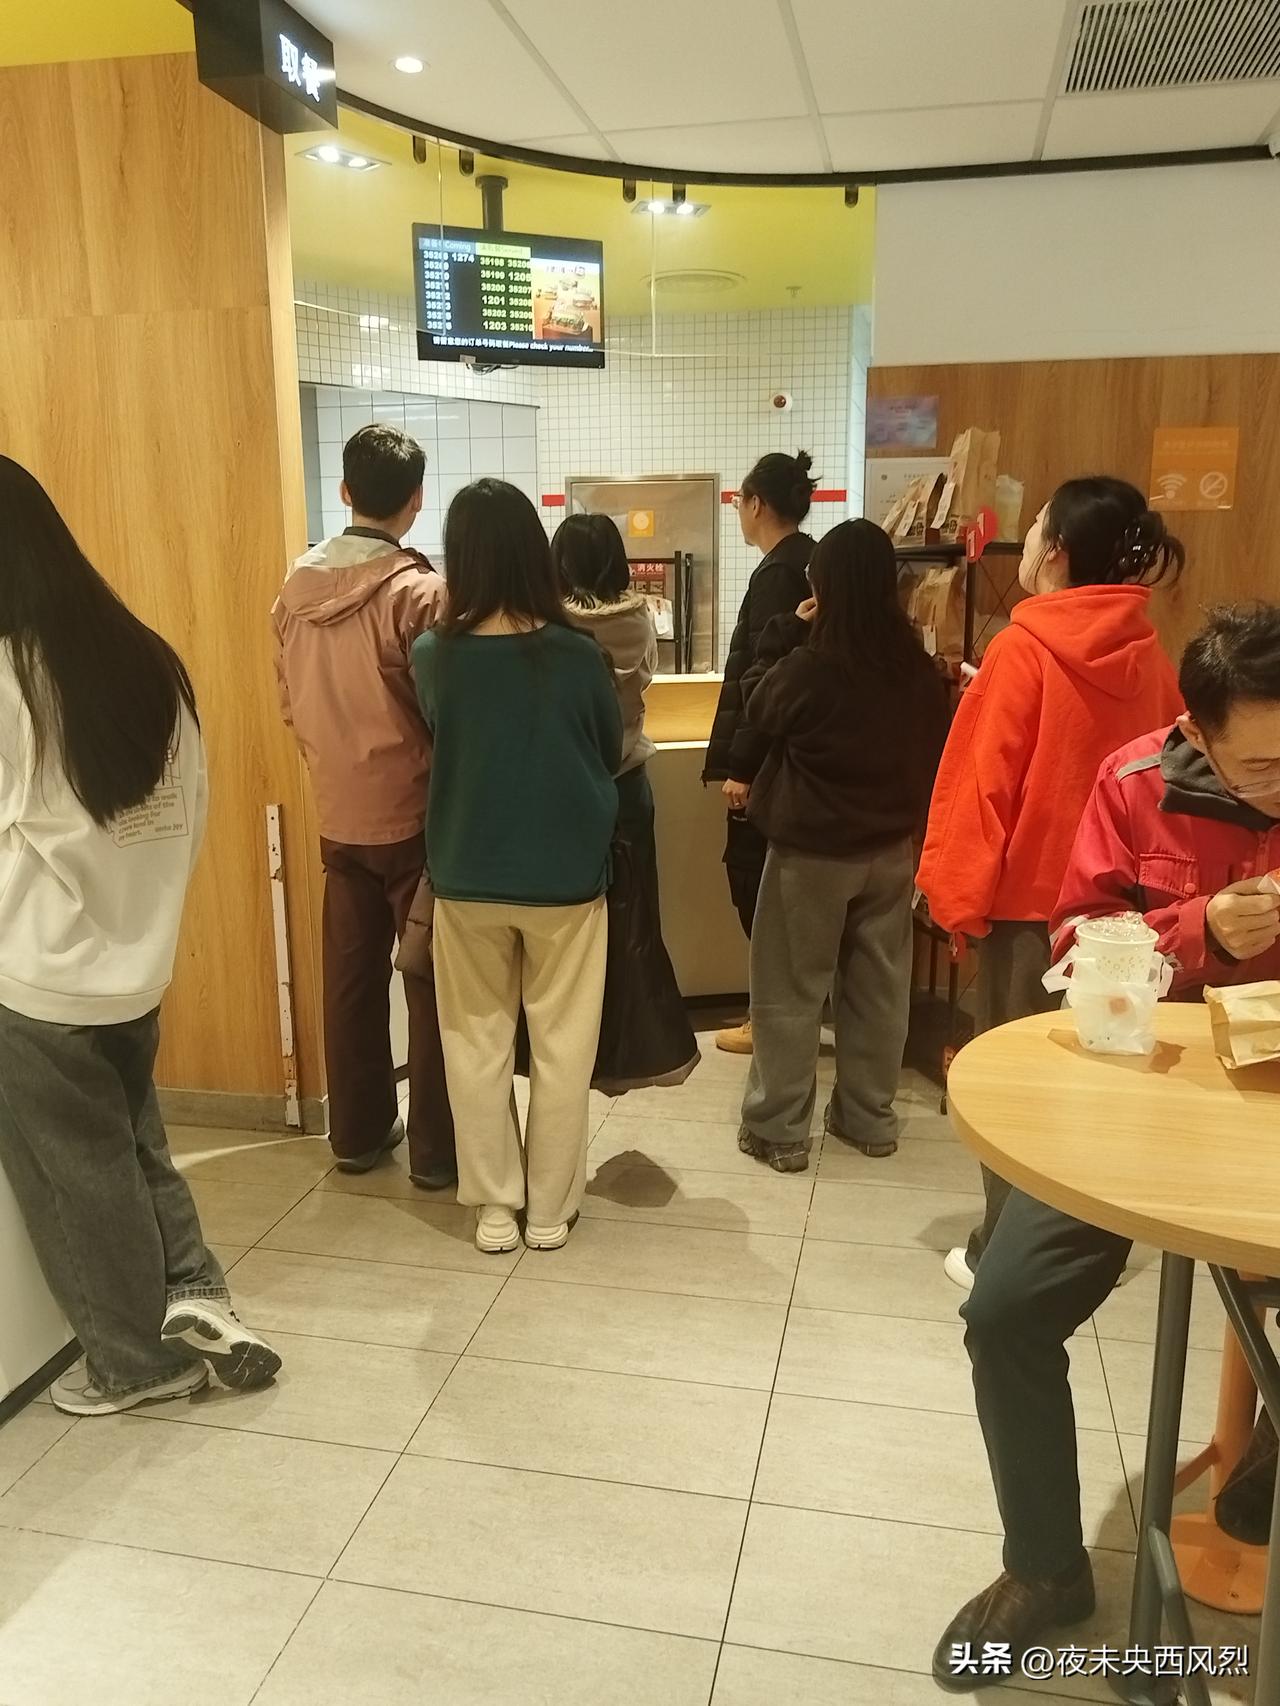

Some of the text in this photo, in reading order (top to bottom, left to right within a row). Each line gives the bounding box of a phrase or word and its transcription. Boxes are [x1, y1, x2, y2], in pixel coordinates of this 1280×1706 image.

[279, 33, 321, 103] 取餐
[451, 253, 475, 263] 1274
[481, 282, 506, 292] 35200
[481, 295, 505, 305] 1201
[482, 308, 506, 317] 35202
[483, 320, 507, 331] 1203
[637, 563, 664, 572] 消火栓
